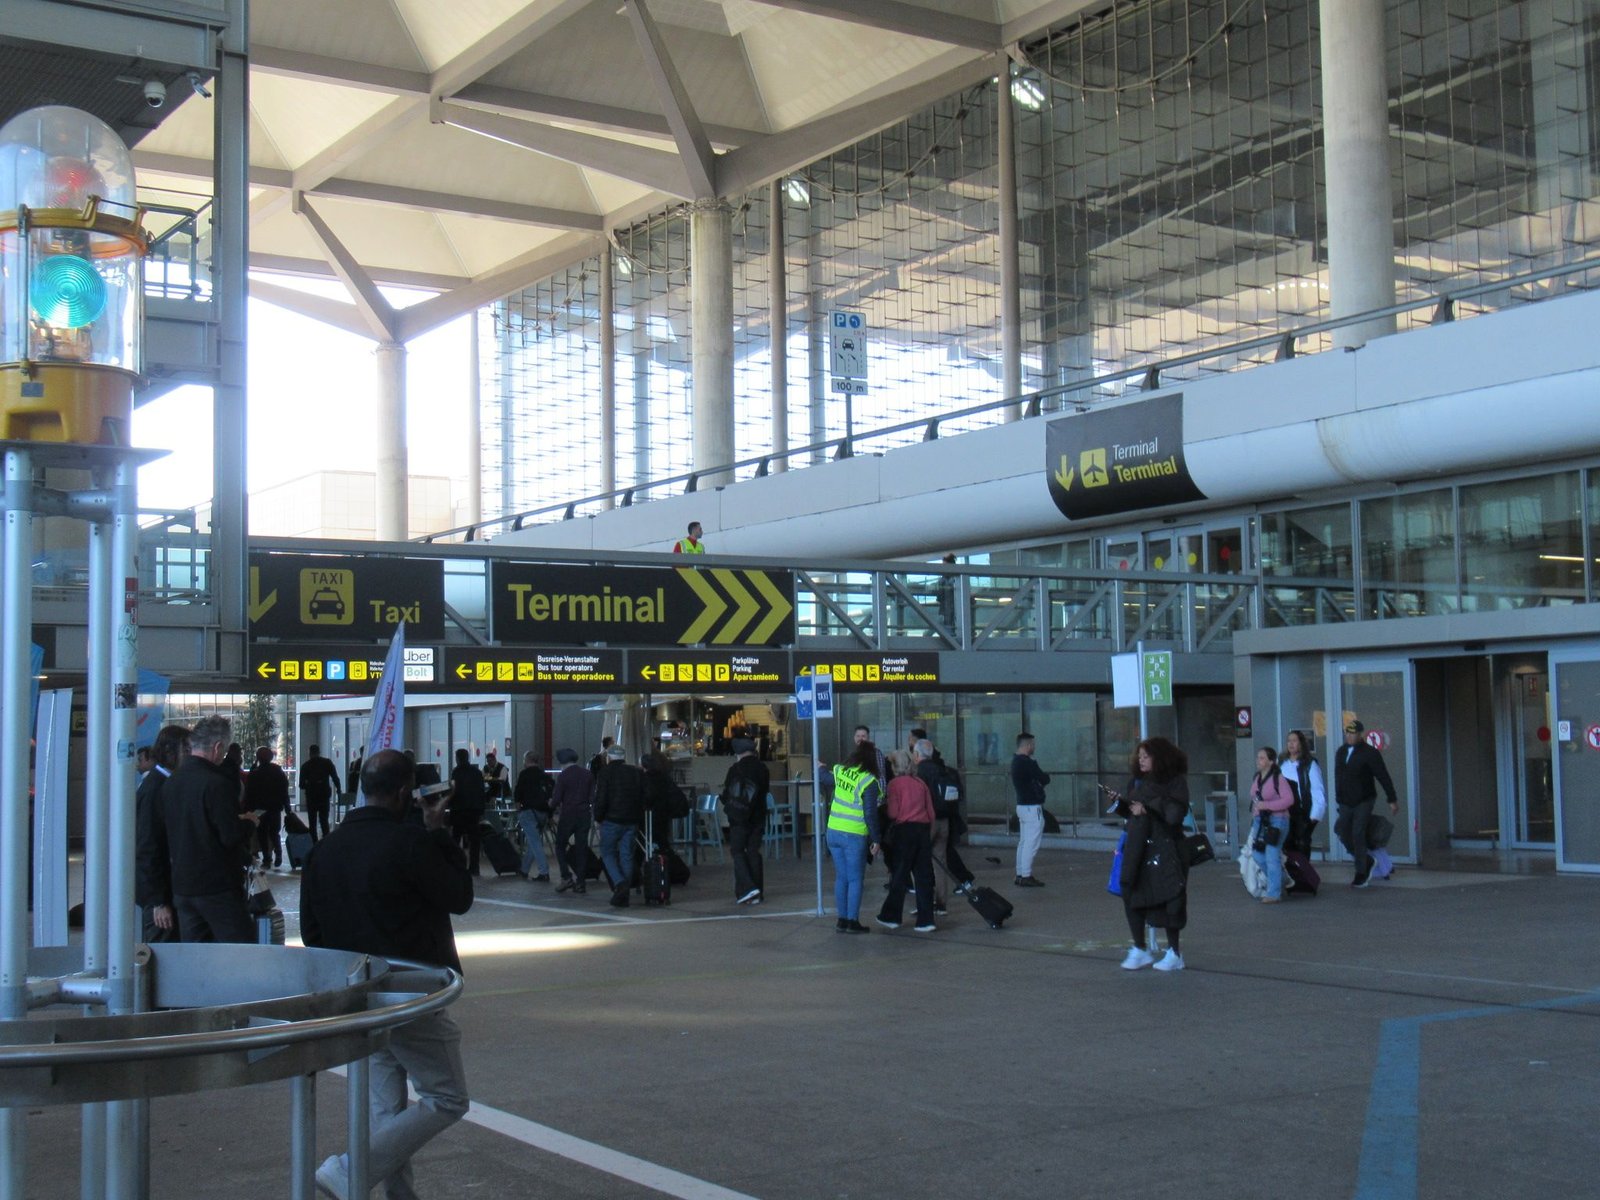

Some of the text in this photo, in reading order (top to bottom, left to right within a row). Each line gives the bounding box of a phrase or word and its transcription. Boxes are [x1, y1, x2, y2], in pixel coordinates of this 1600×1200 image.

[837, 382, 852, 391] 100
[1112, 437, 1158, 460] Terminal
[1114, 455, 1178, 483] Terminal
[311, 572, 343, 585] TAXI
[508, 584, 664, 623] Terminal
[370, 600, 421, 624] Taxi
[537, 655, 599, 664] Busreise-Veranstalter
[330, 663, 340, 679] P
[406, 667, 427, 677] Bolt
[537, 663, 549, 671] Bus
[564, 664, 593, 673] operators
[732, 664, 752, 673] Parking
[537, 672, 615, 682] Bus tour operadores
[719, 670, 727, 679] P
[733, 673, 779, 682] Aparcamiento
[882, 673, 905, 681] Alquiler
